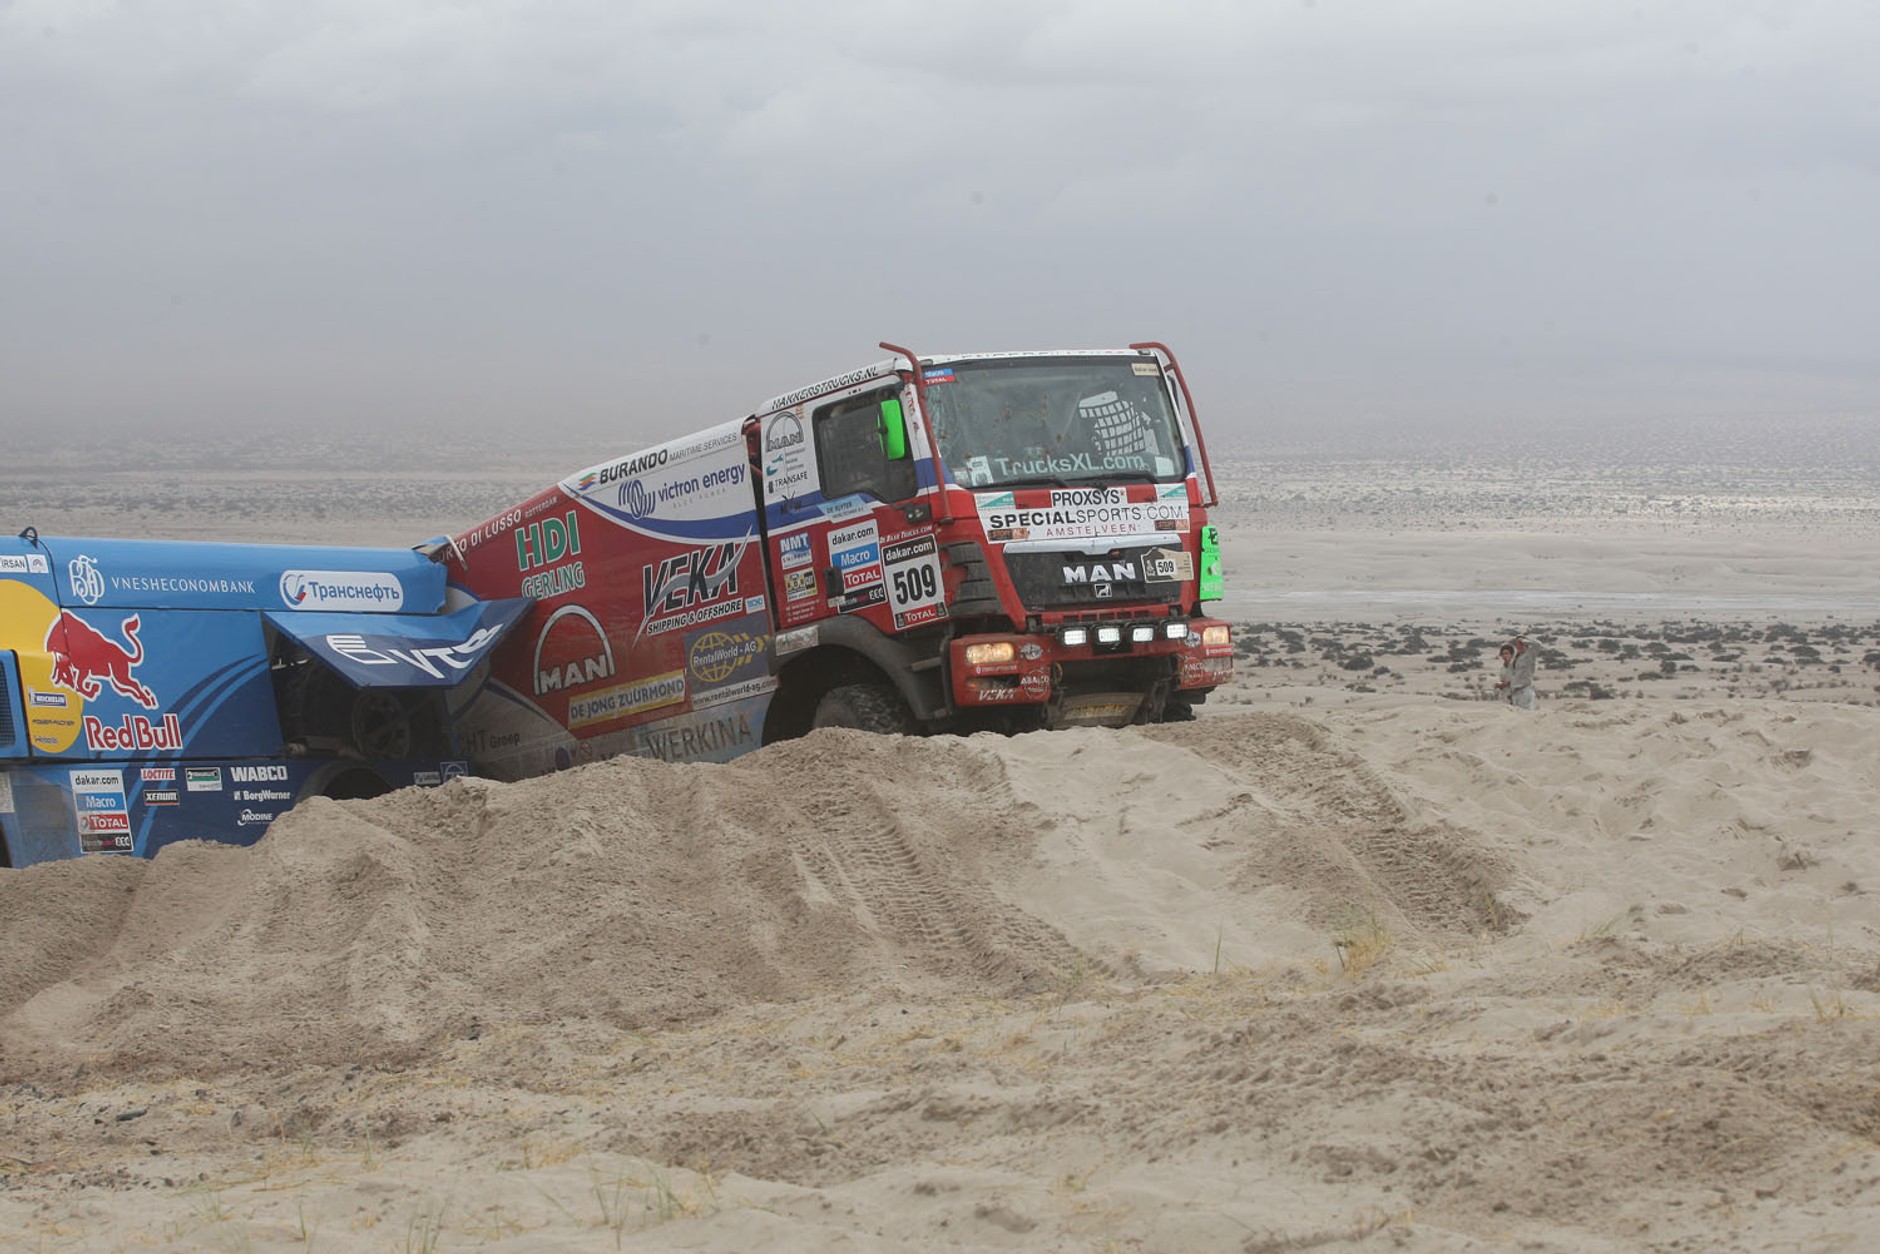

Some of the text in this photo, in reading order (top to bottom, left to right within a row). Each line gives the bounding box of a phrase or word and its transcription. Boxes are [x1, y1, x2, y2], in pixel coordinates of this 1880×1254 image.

[769, 431, 801, 450] MAN
[600, 432, 737, 485] BURANDO MARITIME SERVICES
[994, 453, 1144, 476] TrucksXL.com
[657, 478, 700, 503] victron
[702, 463, 745, 488] energy
[775, 471, 808, 487] TRANSAFE
[1051, 489, 1120, 507] PROXSYS
[989, 505, 1183, 529] SPECIALSPORTS.COM
[471, 530, 482, 547] DI
[485, 509, 522, 539] LUSSO
[832, 526, 874, 546] dakar.com
[1046, 523, 1137, 537] AMSTELVEEN
[515, 510, 581, 572] HDI
[780, 532, 809, 553] NMT
[885, 541, 933, 561] dakar.com
[0, 557, 25, 569] IRSAN
[840, 549, 870, 567] Macro
[1157, 560, 1175, 574] 509
[522, 561, 586, 600] GERLING
[643, 542, 738, 618] VEKA
[844, 570, 880, 586] TOTAL
[1062, 562, 1136, 584] MAN
[111, 576, 256, 594] VNESHECONOMBANK
[308, 581, 400, 603] Транснефть
[892, 563, 938, 605] 509
[648, 598, 743, 635] SHIPPING & OFFSHORE
[905, 610, 936, 623] TOTAL
[693, 645, 739, 665] RentalWorld
[744, 640, 757, 653] AG
[539, 654, 609, 694] MAN
[570, 679, 685, 719] DE JONG ZUURMOND
[83, 713, 182, 750] Red Bull
[646, 713, 757, 762] WERKINA
[75, 774, 119, 785] dakar.com
[142, 769, 174, 780] LOCTITE
[230, 765, 288, 782] WABCO
[86, 796, 116, 808] Macro
[243, 790, 291, 802] BorgWarner
[91, 816, 128, 829] TOTAL
